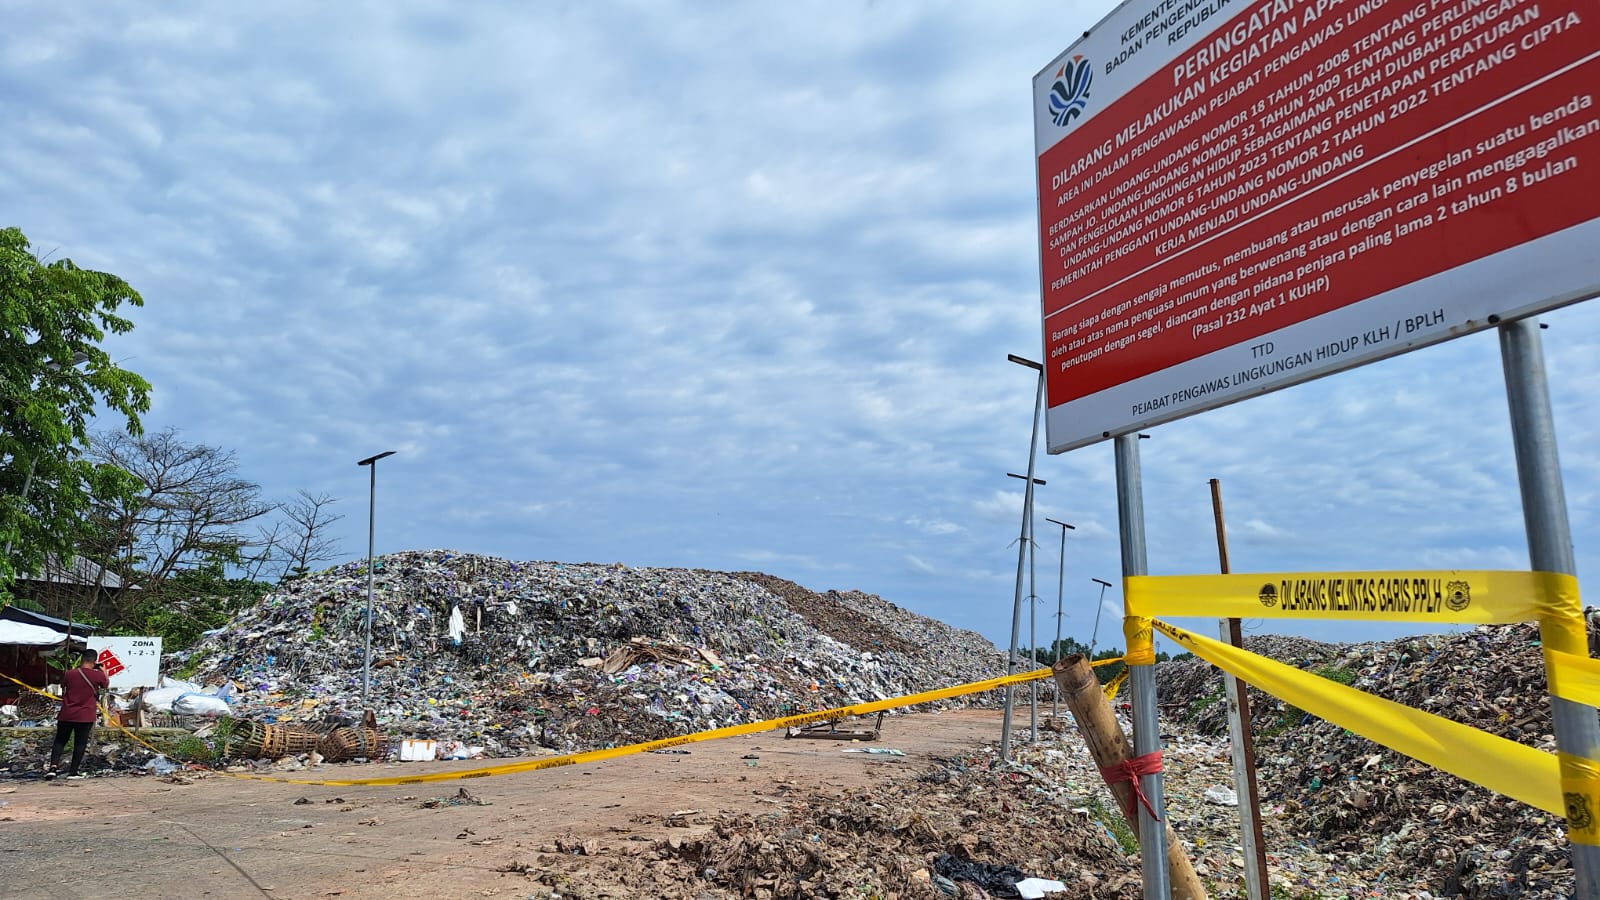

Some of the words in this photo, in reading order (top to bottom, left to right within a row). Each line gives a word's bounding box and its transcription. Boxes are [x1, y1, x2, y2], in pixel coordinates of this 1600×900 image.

[1049, 193, 1108, 236] BERDASARKAN
[1109, 138, 1199, 200] UNDANG-UNDANG
[1201, 110, 1248, 145] NOMOR
[1251, 99, 1266, 117] 18
[1267, 70, 1313, 106] TAHUN
[1316, 48, 1350, 78] 2008
[1352, 3, 1426, 54] TENTANG
[1049, 223, 1083, 250] SAMPAH
[1101, 161, 1189, 220] UNDANG-UNDANG
[1192, 134, 1238, 168] NOMOR
[1241, 123, 1256, 141] 32
[1259, 95, 1304, 129] TAHUN
[1308, 74, 1341, 102] 2009
[1344, 30, 1416, 79] TENTANG
[1051, 257, 1103, 291] PEMERINTAH
[1104, 228, 1158, 264] PENGGANTI
[1160, 174, 1264, 236] UNDANG-UNDANG
[1266, 146, 1319, 182] NOMOR
[1321, 139, 1330, 154] 2
[1332, 110, 1385, 147] TAHUN
[1389, 89, 1428, 119] 2022
[1431, 42, 1516, 96] TENTANG
[1521, 12, 1581, 50] CIPTA
[1052, 139, 1112, 191] DILARANG
[1115, 76, 1206, 149] MELAKUKAN
[1210, 16, 1297, 87] KEGIATAN
[1057, 185, 1080, 208] AREA
[1081, 175, 1093, 193] INI
[1095, 153, 1129, 184] DALAM
[1131, 104, 1207, 161] PENGAWASAN
[1209, 69, 1261, 112] PEJABAT
[1264, 17, 1344, 78] PENGAWAS
[1347, 0, 1388, 26] LING
[1060, 240, 1077, 257] DAN
[1078, 206, 1138, 247] PENGELOLAAN
[1139, 169, 1205, 213] LINGKUNGAN
[1206, 148, 1242, 176] HIDUP
[1244, 96, 1336, 156] SEBAGAIMANA
[1337, 69, 1381, 102] TELAH
[1385, 33, 1446, 77] DIUBAH
[1063, 219, 1143, 270] UNDANG-UNDANG
[1144, 196, 1185, 226] NOMOR
[1187, 191, 1194, 204] 6
[1196, 168, 1236, 198] TAHUN
[1239, 152, 1268, 177] 2023
[1270, 116, 1332, 159] TENTANG
[1335, 66, 1425, 125] PENETAPAN
[1430, 4, 1539, 74] PERATURAN
[1105, 38, 1143, 76] BADAN
[1051, 344, 1067, 358] oleh
[1068, 337, 1086, 351] atau
[1087, 329, 1104, 343] atas
[1105, 319, 1129, 335] nama
[1131, 299, 1175, 327] penguasa
[1176, 285, 1209, 306] umum
[1211, 273, 1238, 294] yang
[1239, 243, 1307, 279] berwenang
[1309, 230, 1338, 251] atau
[1341, 207, 1393, 237] dengan
[1396, 192, 1429, 213] cara
[1432, 178, 1462, 198] lain
[1466, 119, 1600, 184] menggagalkan
[1052, 324, 1078, 342] Barang
[1078, 314, 1100, 330] siapa
[1100, 300, 1132, 320] dengan
[1133, 283, 1168, 306] sengaja
[1169, 262, 1221, 290] memutus,
[1223, 230, 1288, 267] membuang
[1290, 217, 1319, 237] atau
[1321, 187, 1380, 223] merusak
[1383, 148, 1472, 199] penyegelan
[1476, 124, 1525, 155] suatu
[1530, 95, 1592, 131] benda
[1061, 347, 1103, 372] penutupan
[1104, 334, 1136, 353] dengan
[1137, 320, 1164, 340] segel,
[1165, 305, 1208, 329] diancam
[1210, 288, 1251, 311] dengan
[1253, 270, 1294, 297] pidana
[1296, 250, 1346, 281] penjara
[1349, 230, 1393, 260] paling
[1395, 214, 1433, 238] lama
[1437, 205, 1447, 221] 2
[1451, 186, 1502, 215] tahun
[1506, 177, 1518, 193] 8
[1522, 156, 1577, 187] bulan
[1155, 233, 1186, 257] KERJA
[1188, 206, 1239, 241] MENJADI
[1241, 144, 1364, 215] UNDANG-UNDANG
[1132, 394, 1170, 417] PEJABAT
[1171, 376, 1231, 405] PENGAWAS
[1232, 350, 1313, 386] LINGKUNGAN
[1316, 335, 1359, 361] HIDUP
[1362, 325, 1390, 347] KLH
[1394, 320, 1401, 340] /
[1405, 308, 1445, 334] BPLH
[1192, 315, 1223, 340] (Pasal
[1226, 307, 1247, 325] 232
[1249, 297, 1276, 317] Ayat
[1278, 292, 1286, 306] 1
[1289, 274, 1330, 302] KUHP)
[1250, 341, 1274, 359] TTD
[1281, 579, 1326, 611] DILARANG
[1328, 578, 1376, 612] MELINTAS
[1378, 578, 1410, 612] GARIS
[1412, 578, 1441, 613] PPLH
